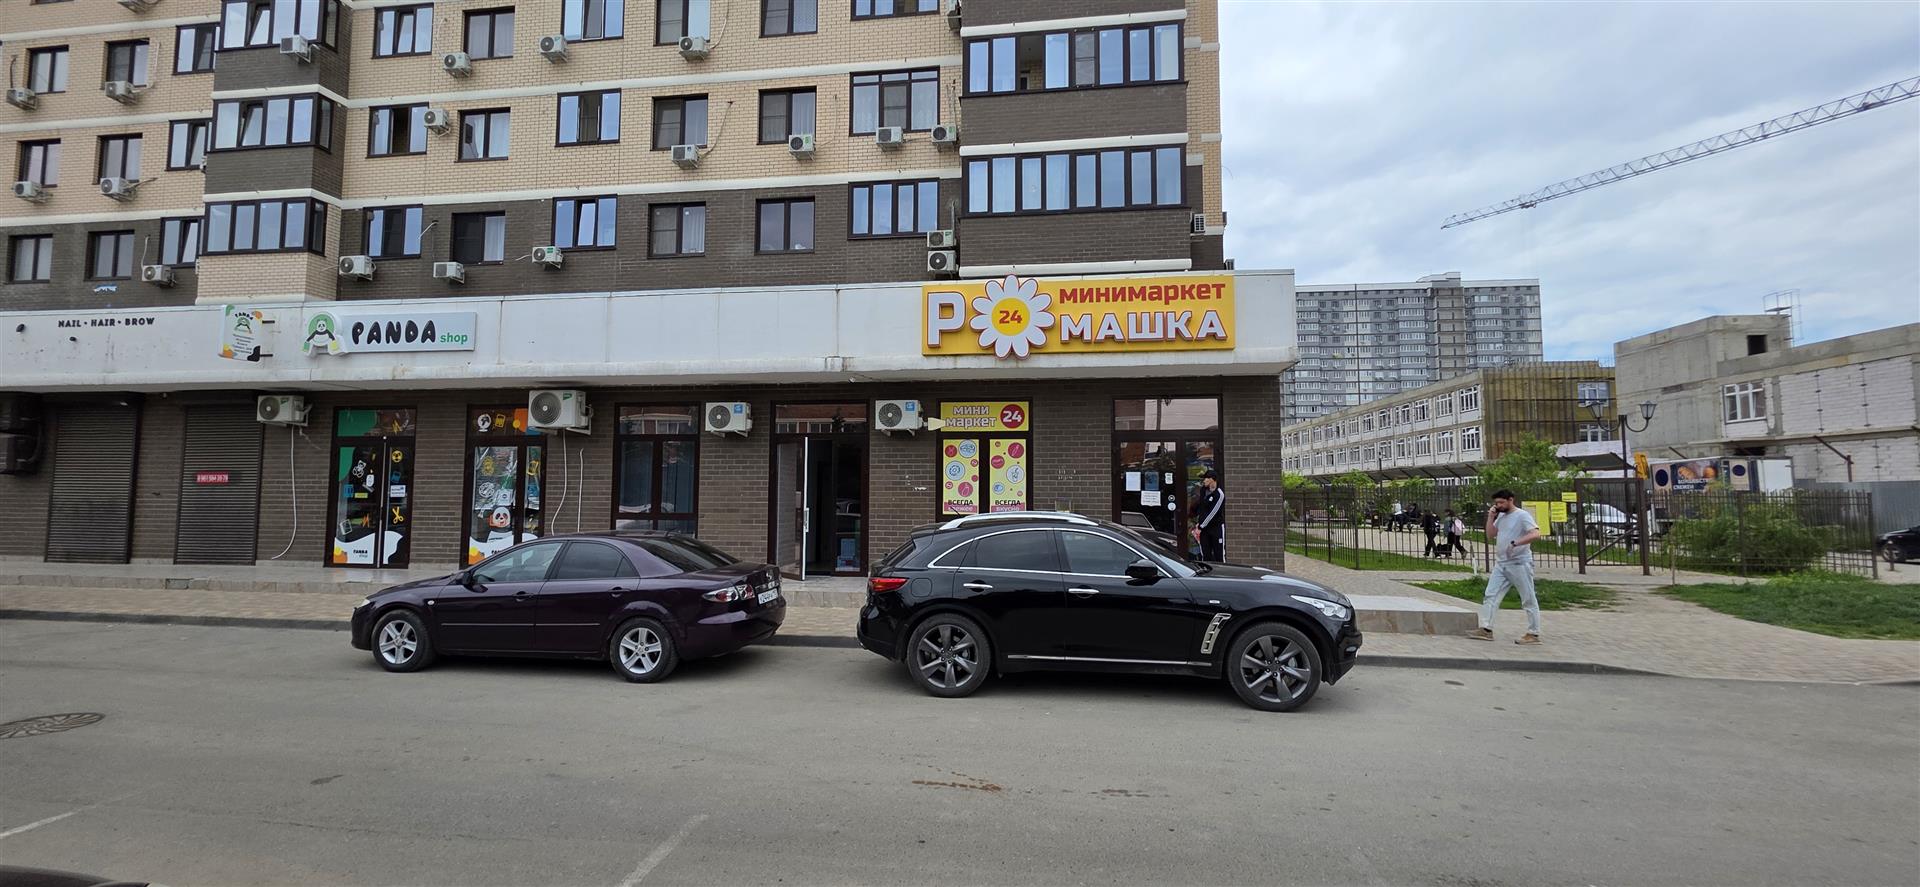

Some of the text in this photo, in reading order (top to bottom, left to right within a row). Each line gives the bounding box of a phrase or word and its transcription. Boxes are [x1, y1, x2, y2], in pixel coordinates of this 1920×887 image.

[1059, 283, 1226, 305] минимаркет
[57, 317, 155, 328] NAIL HAIR BROW
[999, 309, 1023, 324] 24
[351, 319, 468, 345] PANDA shop
[945, 416, 997, 429] маркет
[1002, 410, 1023, 423] 24
